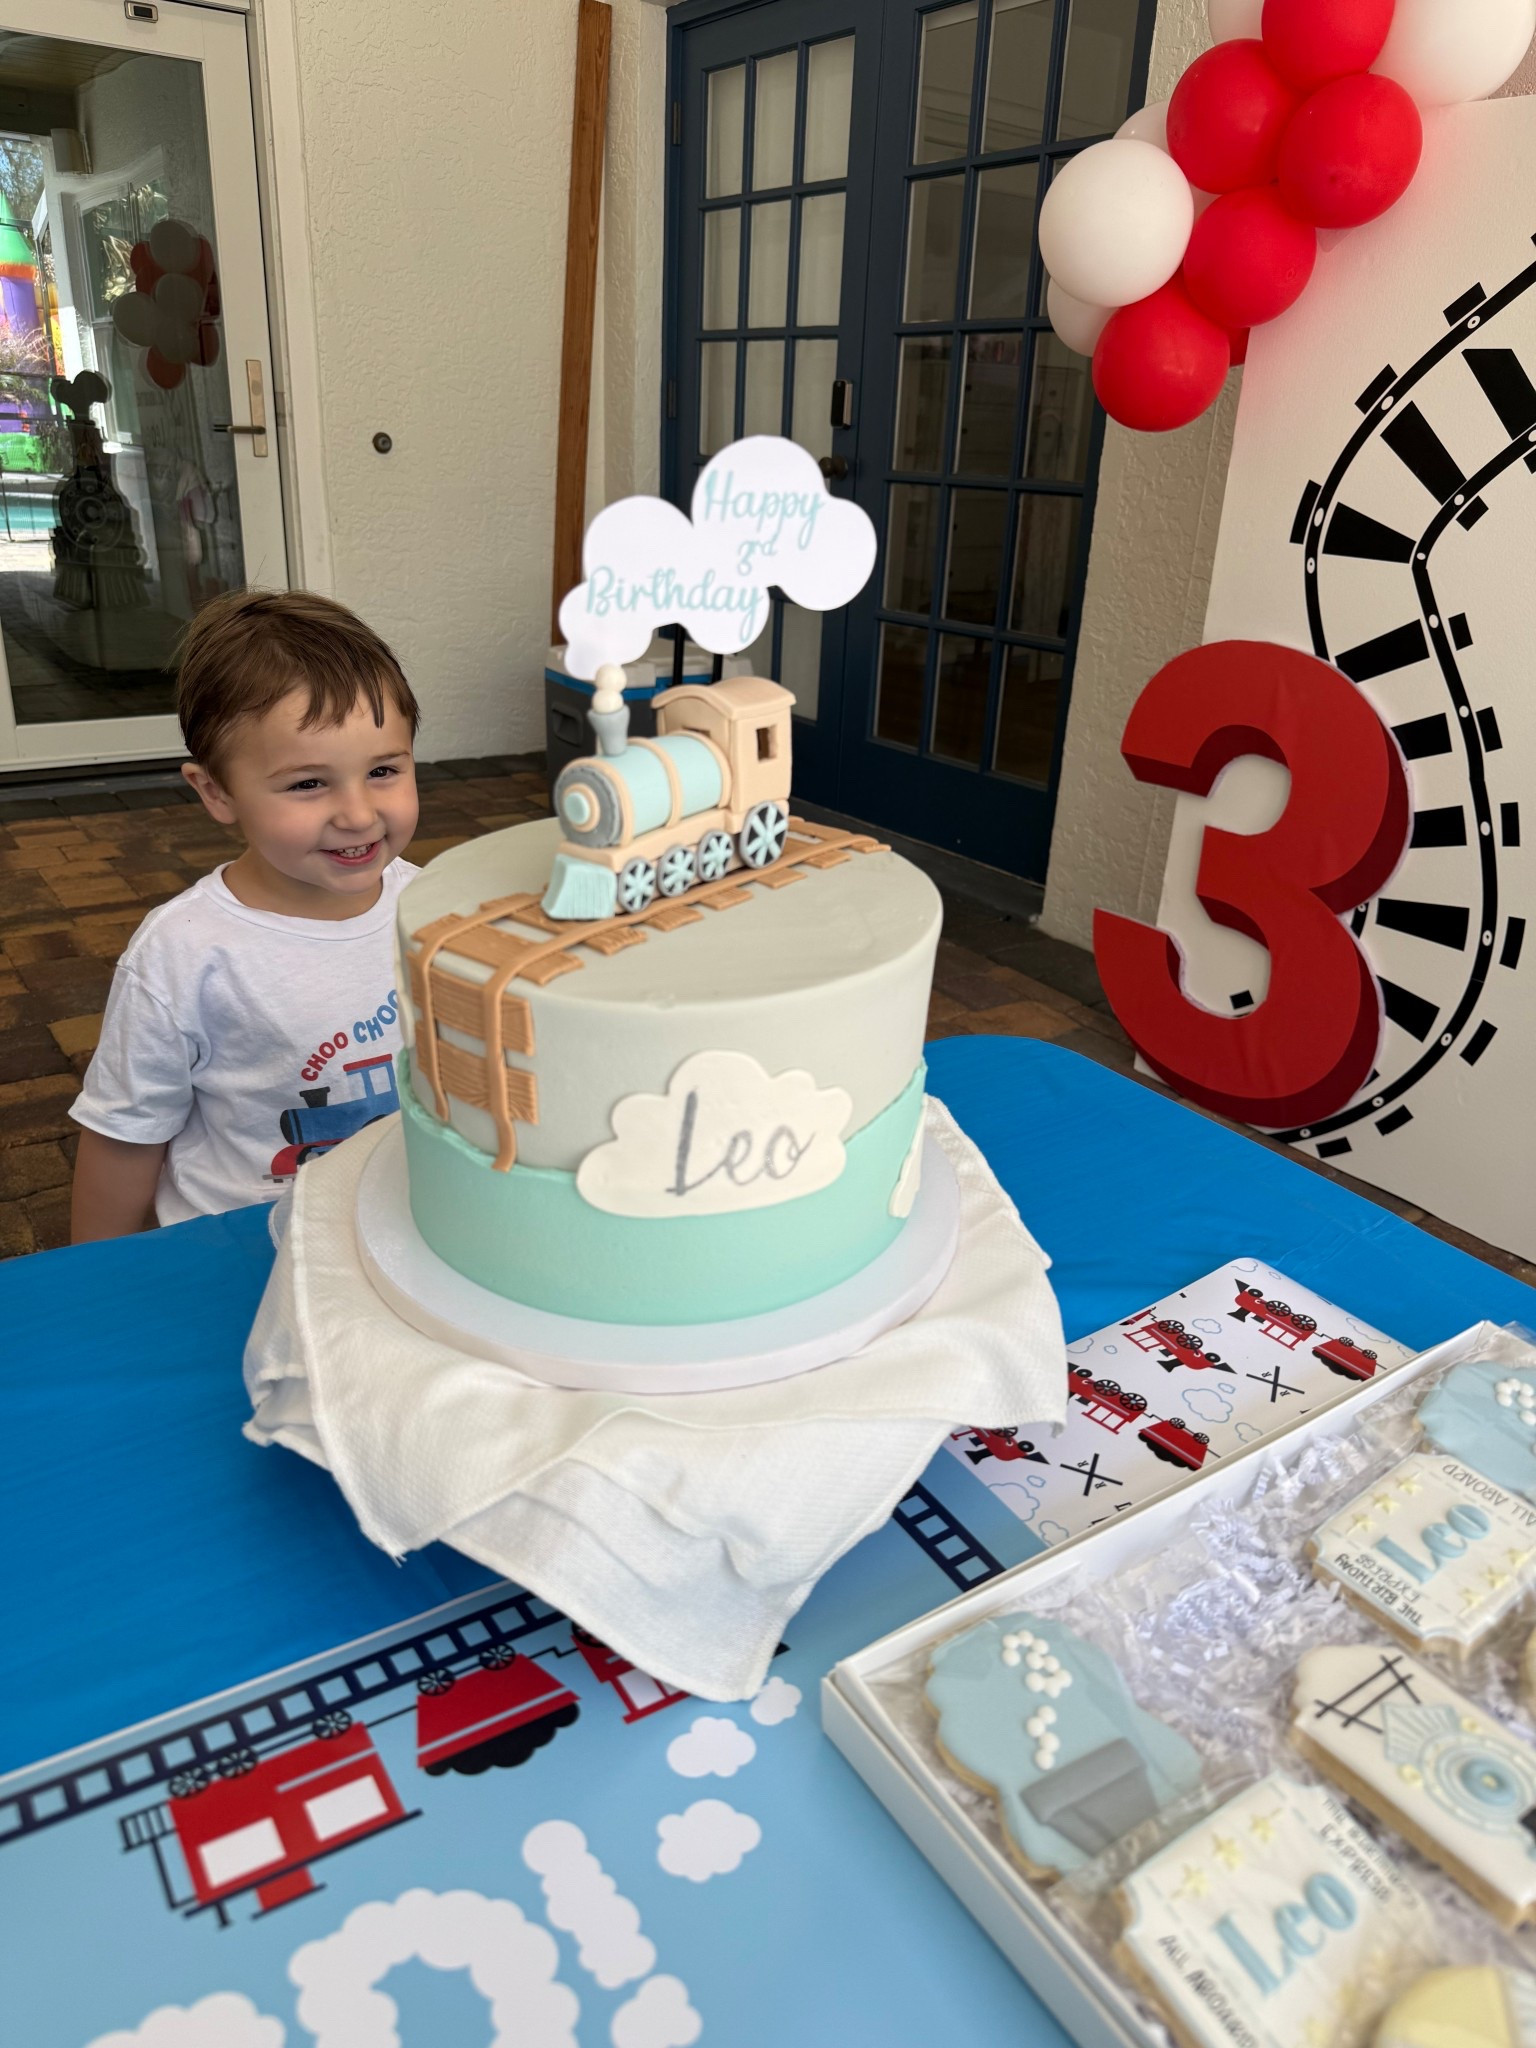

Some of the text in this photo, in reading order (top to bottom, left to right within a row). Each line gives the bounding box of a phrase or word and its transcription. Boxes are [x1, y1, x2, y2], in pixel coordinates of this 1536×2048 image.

[704, 469, 823, 550] Happy
[737, 534, 778, 576] 3rd
[586, 566, 764, 644] Birthday
[1092, 639, 1414, 1130] 3
[301, 1031, 349, 1082] CHOO
[665, 1090, 816, 1197] Leo
[1442, 1464, 1510, 1506] ABOARD
[1375, 1503, 1491, 1584] Leo
[1334, 1553, 1423, 1626] THE BIRTHDAY
[1212, 1871, 1358, 1998] Leo
